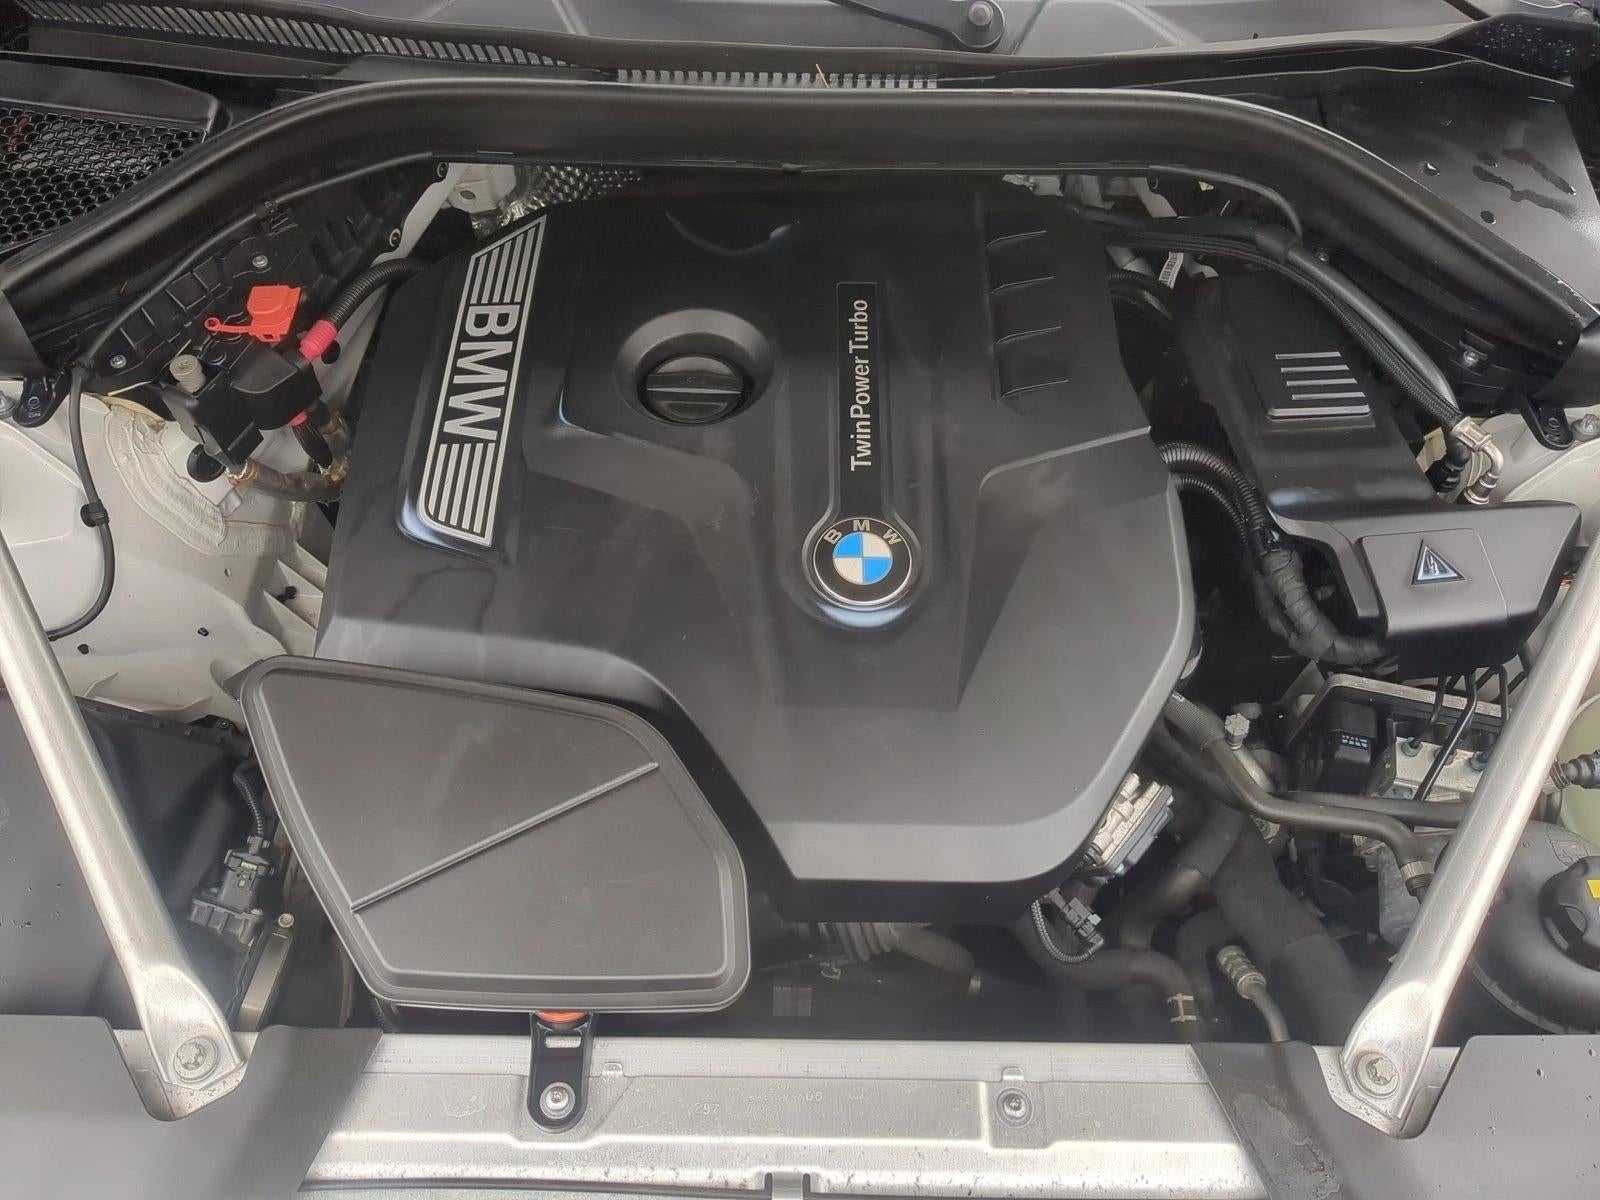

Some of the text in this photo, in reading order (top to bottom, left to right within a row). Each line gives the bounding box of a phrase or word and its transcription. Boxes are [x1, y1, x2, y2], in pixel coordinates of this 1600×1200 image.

[443, 305, 520, 440] BMW
[848, 299, 872, 471] TwinPower Turbo
[823, 519, 902, 546] BMW
